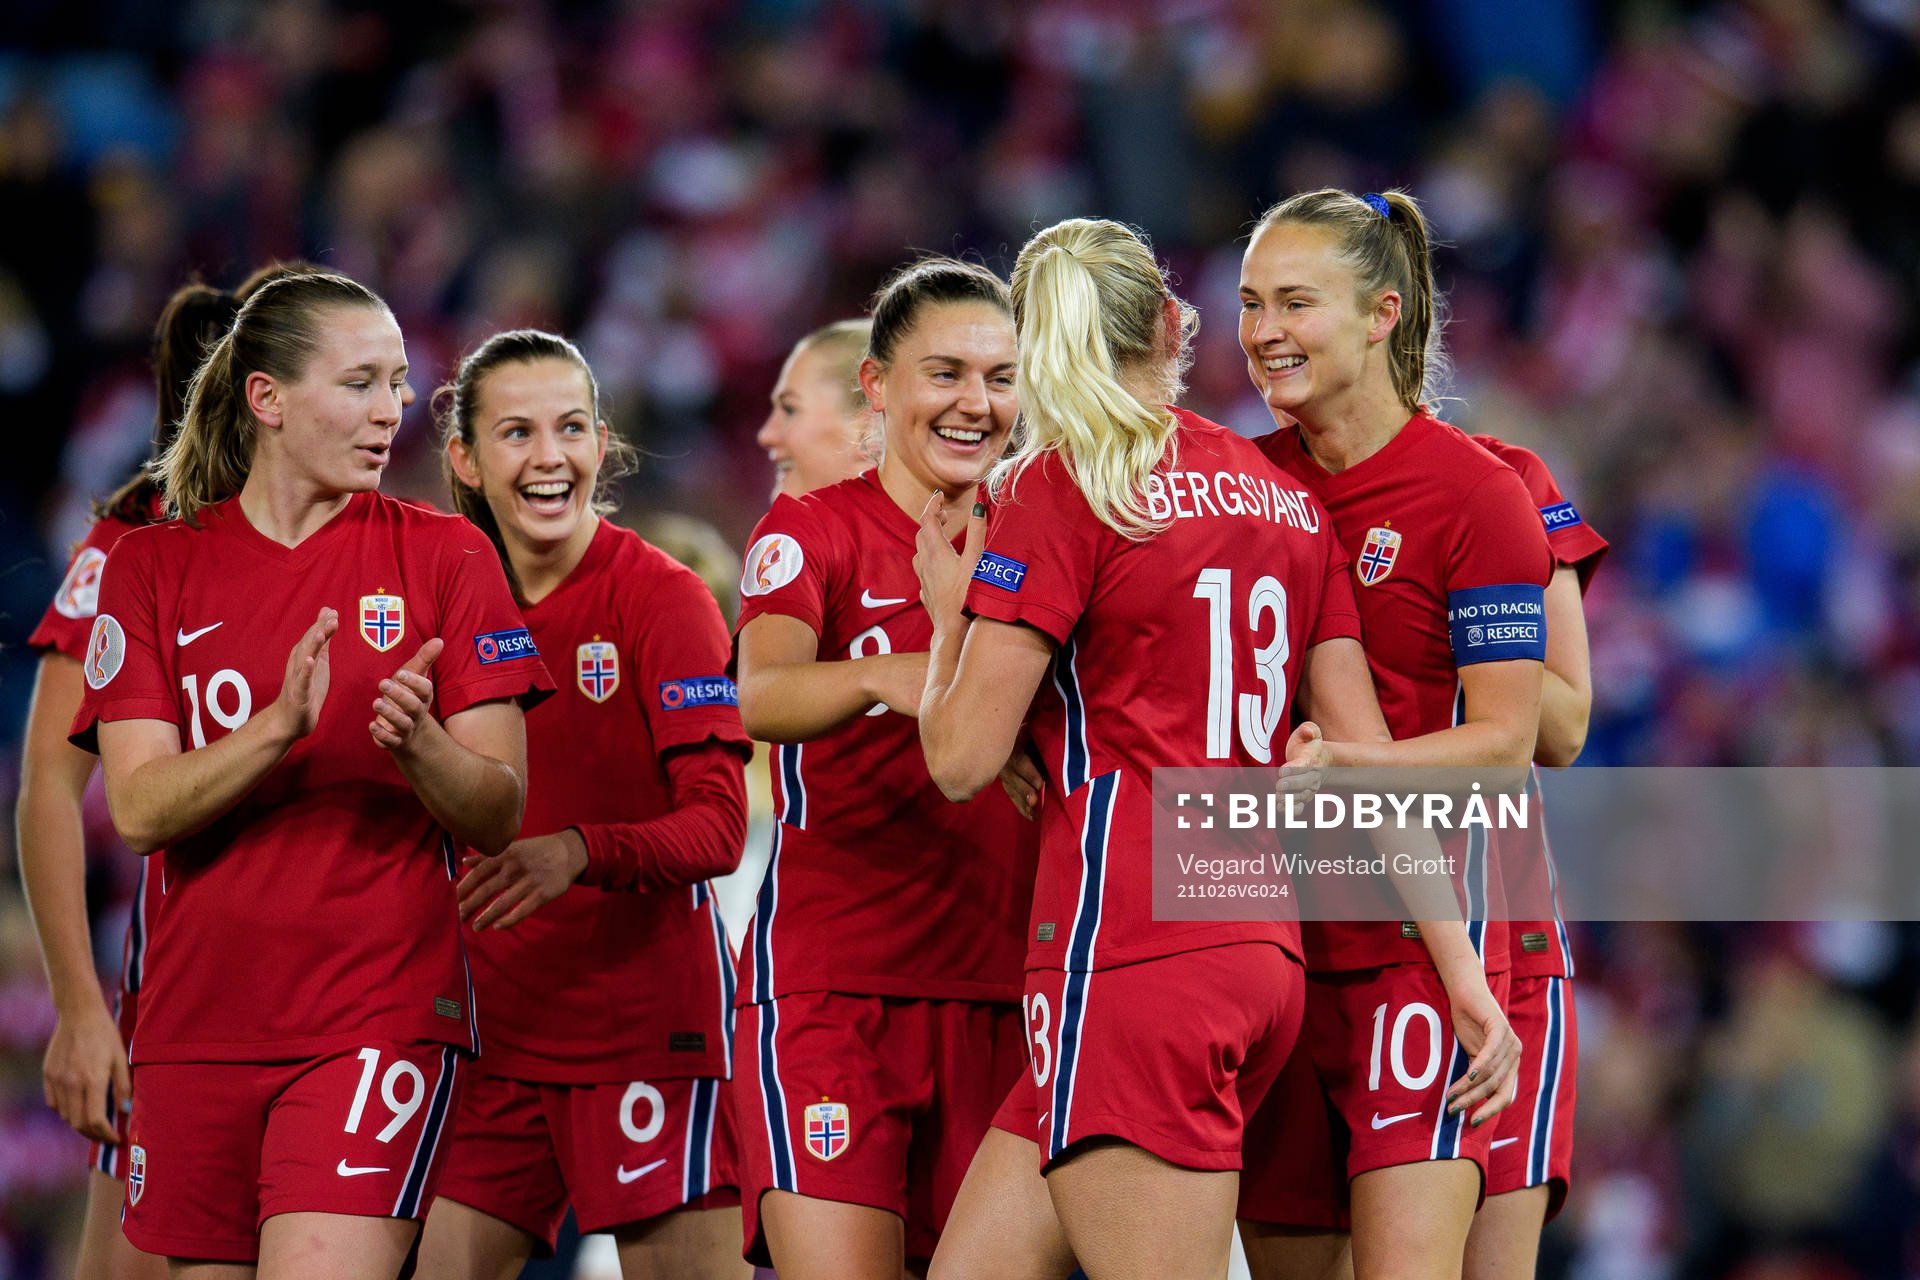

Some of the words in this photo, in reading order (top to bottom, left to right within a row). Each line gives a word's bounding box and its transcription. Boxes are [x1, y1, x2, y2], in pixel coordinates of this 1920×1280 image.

[1148, 471, 1320, 534] BERGSVAND
[975, 558, 1024, 584] SPECT
[1458, 606, 1478, 619] NO
[1480, 604, 1498, 616] TO
[1501, 602, 1541, 615] RACISM
[1192, 568, 1290, 765] 13
[1487, 626, 1539, 640] RESPECT
[182, 669, 252, 750] 19
[1023, 992, 1052, 1088] 13
[1368, 1002, 1442, 1091] 10
[343, 1047, 426, 1144] 19
